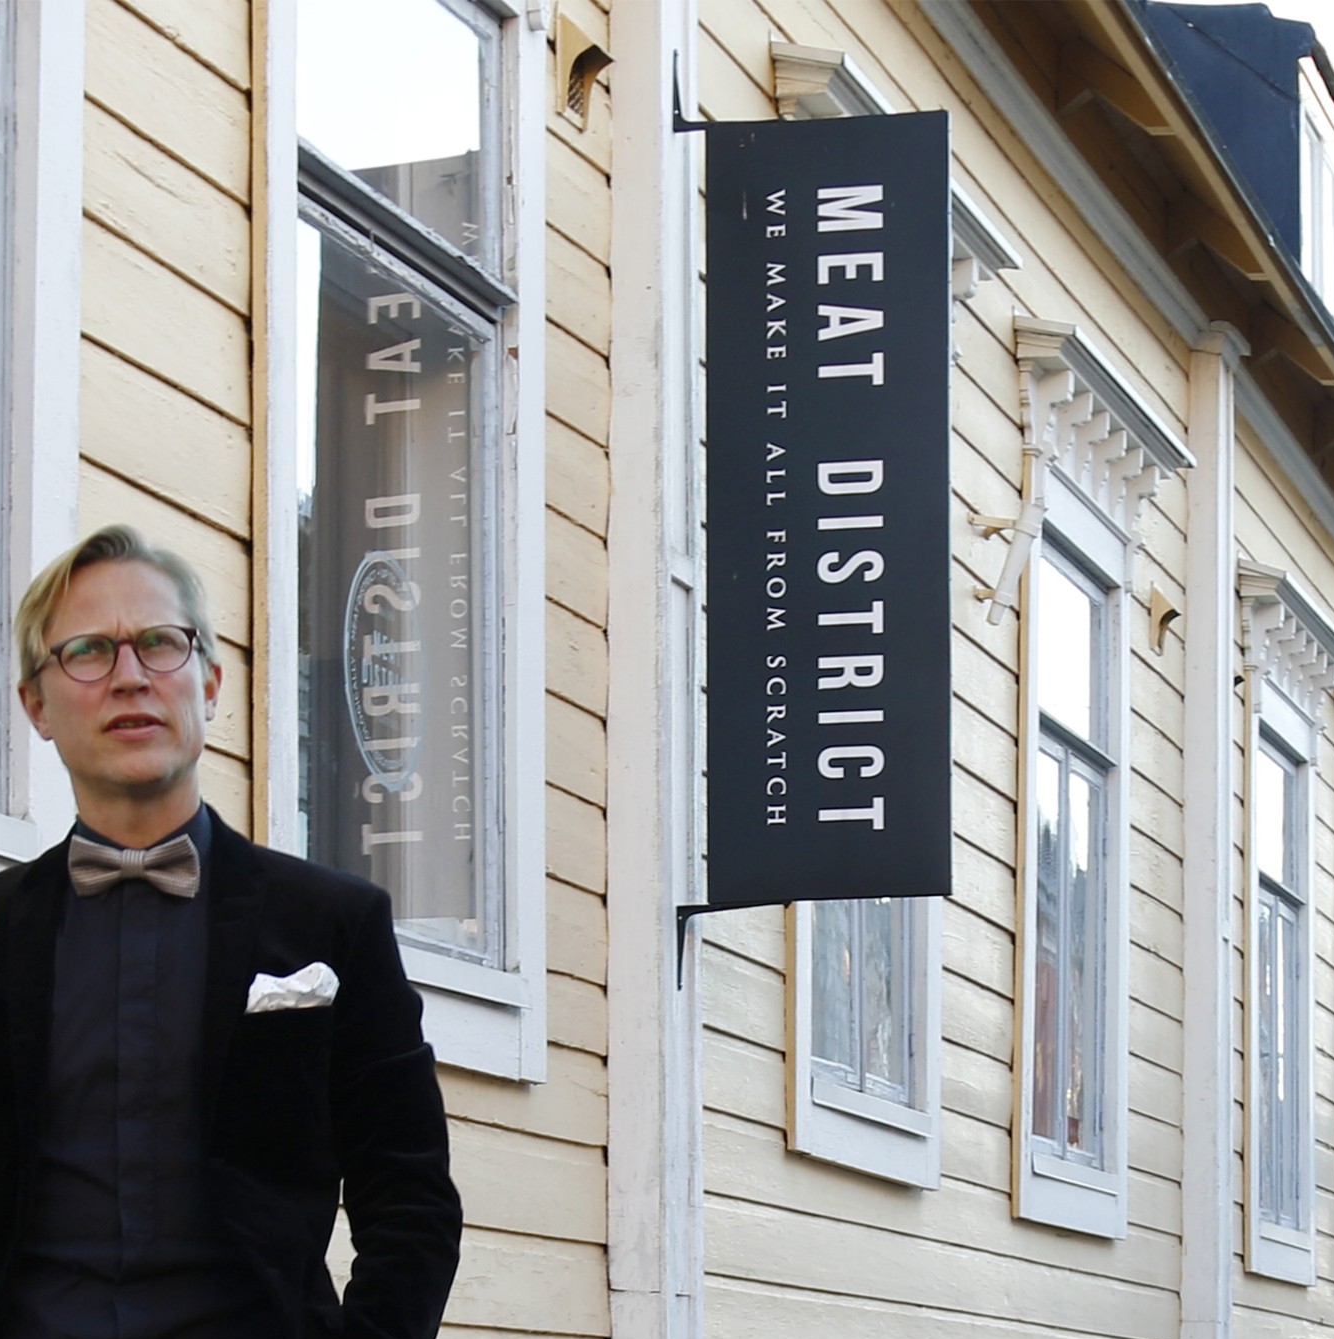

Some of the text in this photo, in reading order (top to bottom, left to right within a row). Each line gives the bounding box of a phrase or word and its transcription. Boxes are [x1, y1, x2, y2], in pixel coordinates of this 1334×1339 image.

[766, 189, 786, 824] WE MAKE IT ALL FROM SCRATCH
[817, 185, 884, 829] MEAT DISTRICT
